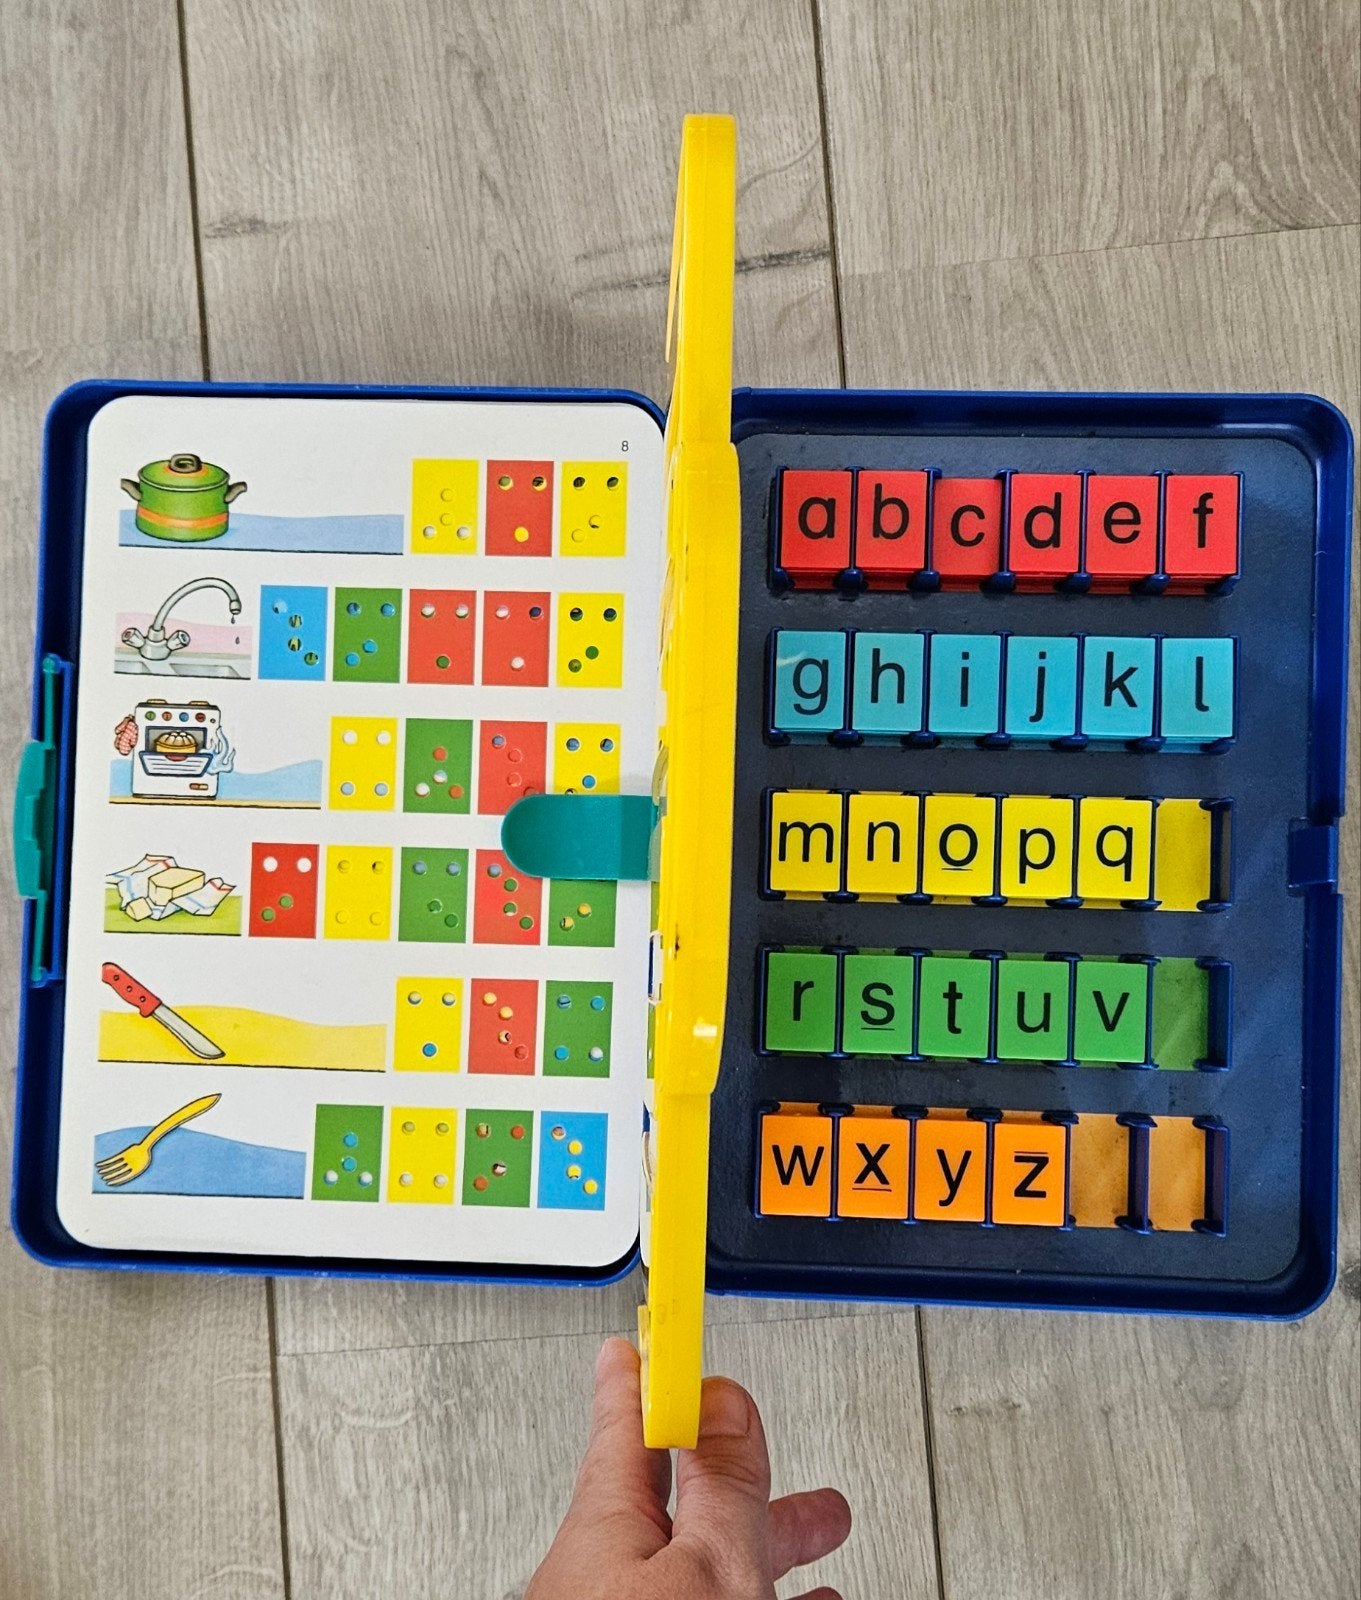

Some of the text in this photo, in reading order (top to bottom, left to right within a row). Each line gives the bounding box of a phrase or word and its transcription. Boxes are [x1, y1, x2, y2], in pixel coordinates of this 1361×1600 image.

[620, 440, 630, 452] 8
[797, 483, 1214, 550] a b c d e f
[792, 647, 1210, 723] g h i j k l
[778, 821, 1134, 885] m n o p q
[792, 980, 1130, 1035] r s t u v
[771, 1142, 1050, 1207] w x y z
